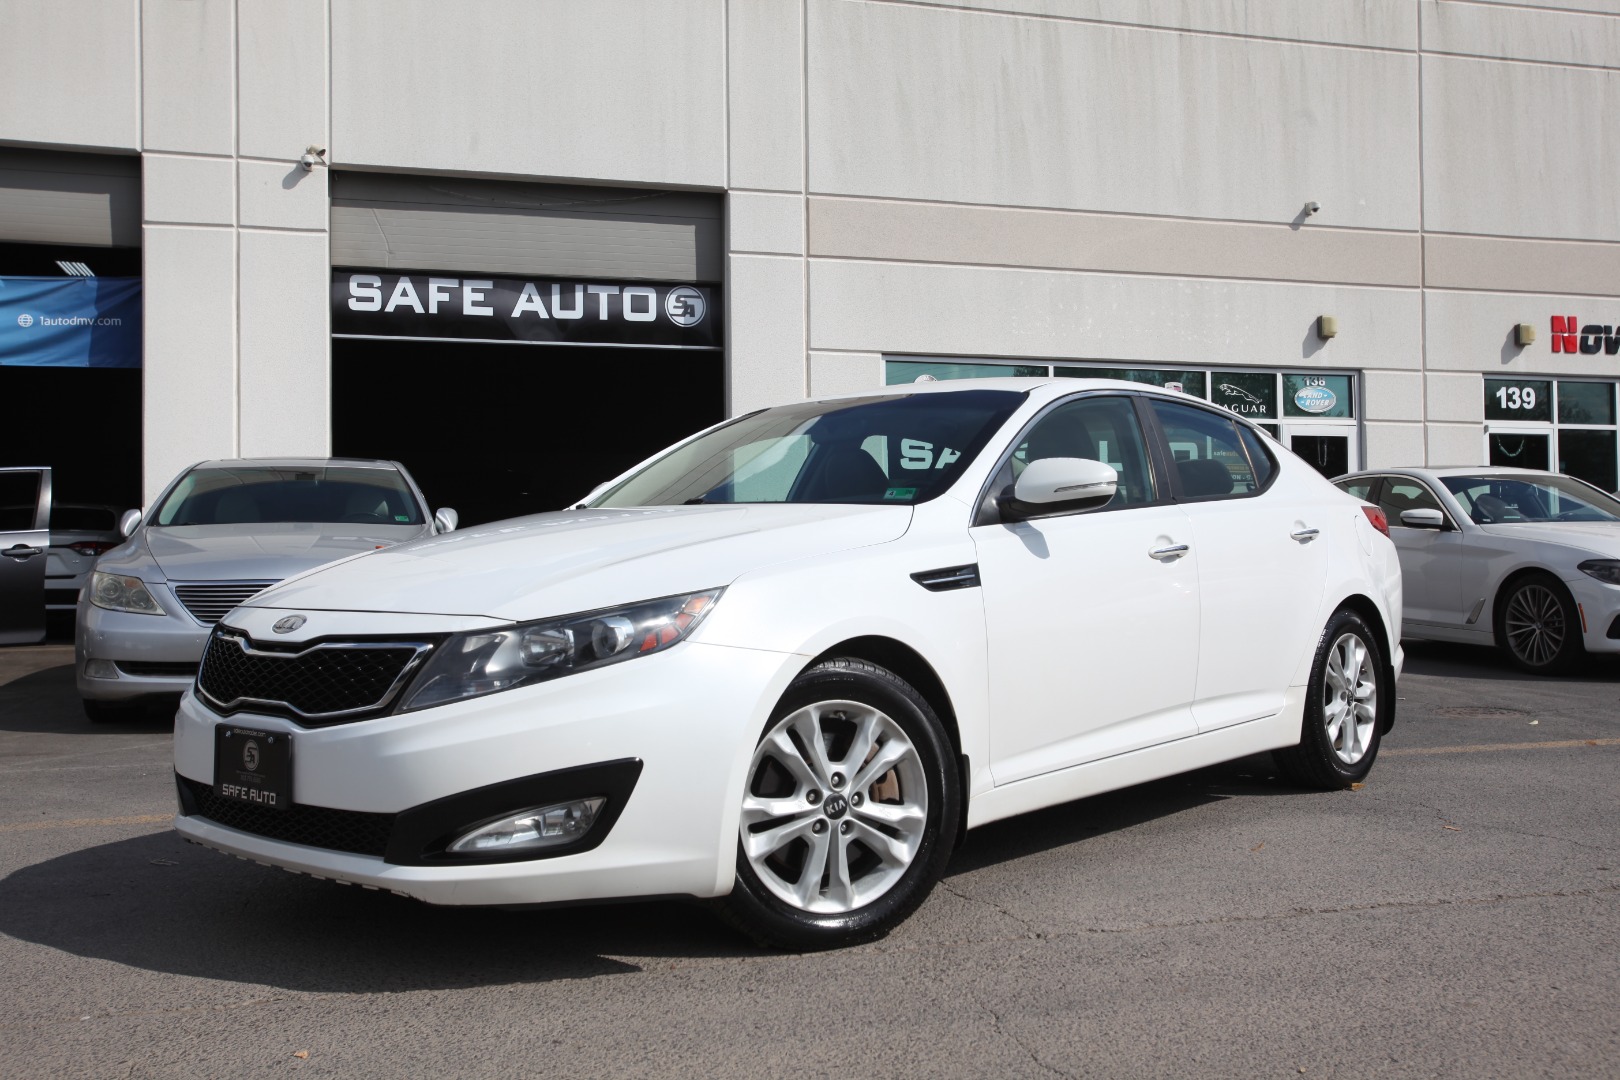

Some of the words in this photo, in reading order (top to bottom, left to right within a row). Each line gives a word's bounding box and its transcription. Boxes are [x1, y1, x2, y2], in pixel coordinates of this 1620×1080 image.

[347, 274, 494, 317] SAFE
[511, 282, 657, 322] AUTO
[40, 316, 122, 326] 1autodmv.com
[1304, 376, 1326, 386] 138
[1303, 391, 1323, 399] LAND
[1496, 387, 1536, 409] 139
[1222, 404, 1267, 414] AGUAR
[222, 783, 247, 799] SAFE
[249, 788, 276, 805] AUTO
[825, 799, 846, 815] KIA
